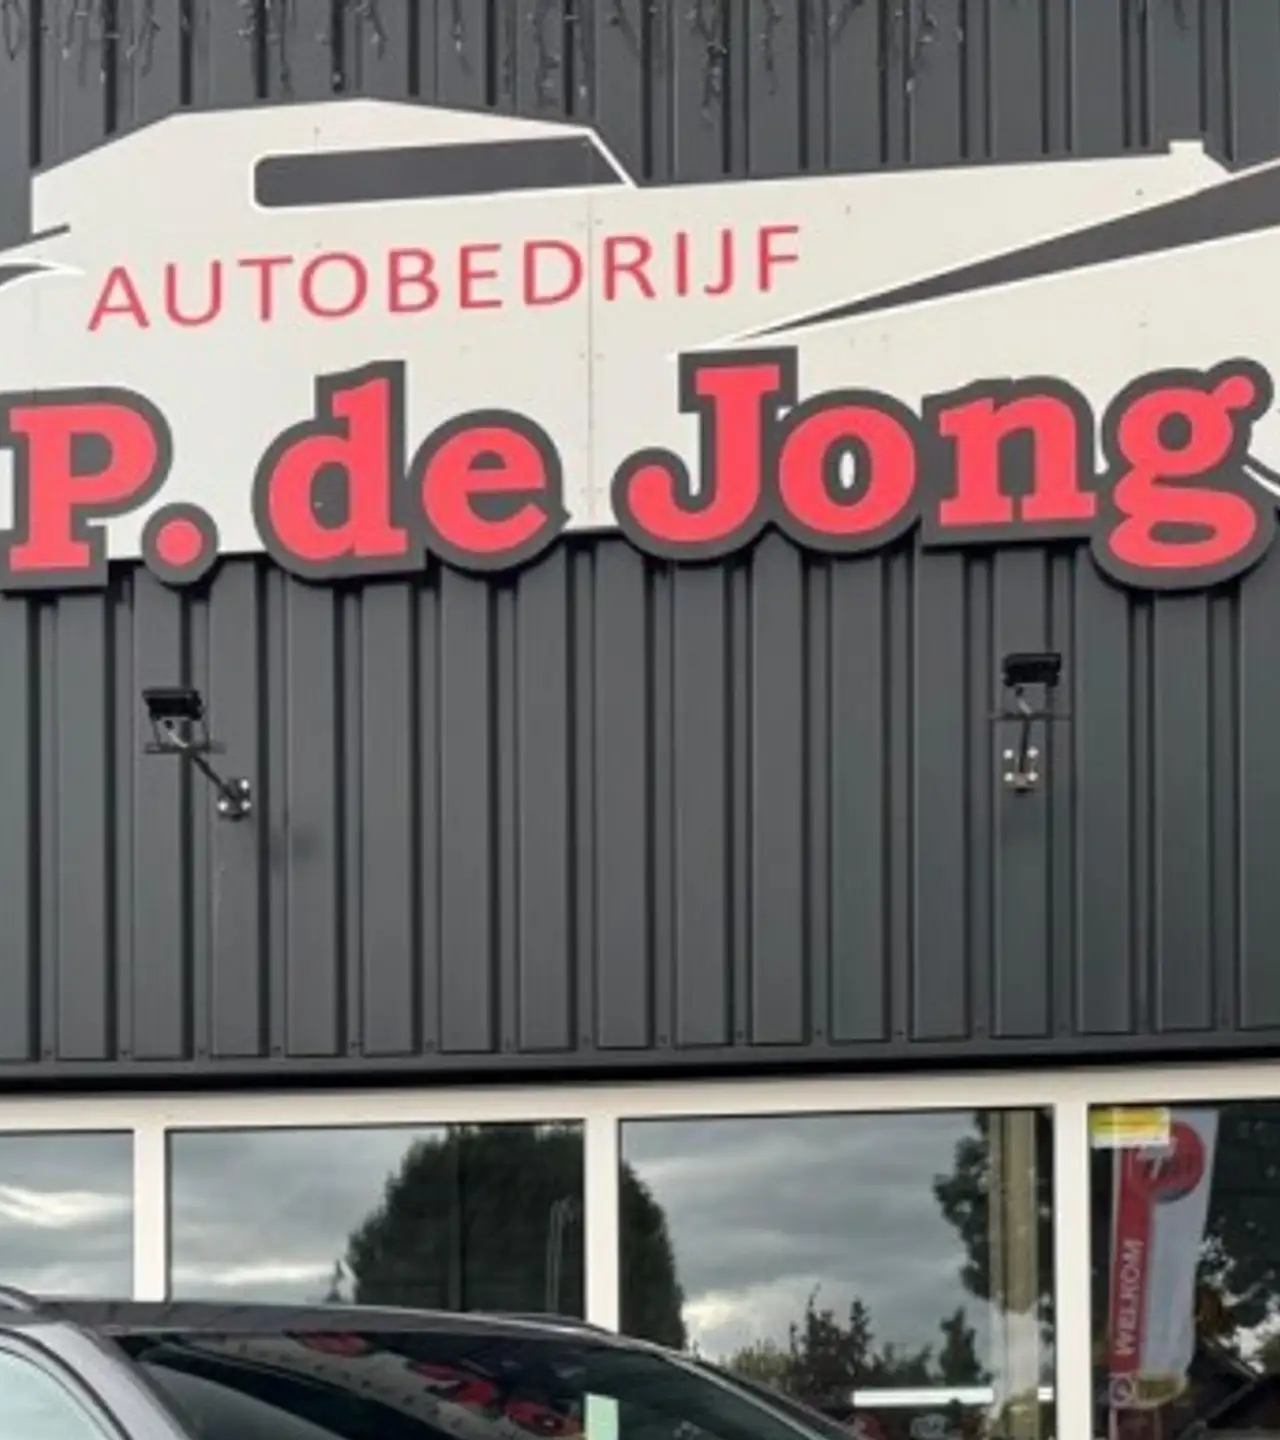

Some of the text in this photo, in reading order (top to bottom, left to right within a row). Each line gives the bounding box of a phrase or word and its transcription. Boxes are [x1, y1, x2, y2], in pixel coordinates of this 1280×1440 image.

[87, 225, 800, 331] AUTOBEDRIJF
[8, 362, 1257, 570] P. de Jong
